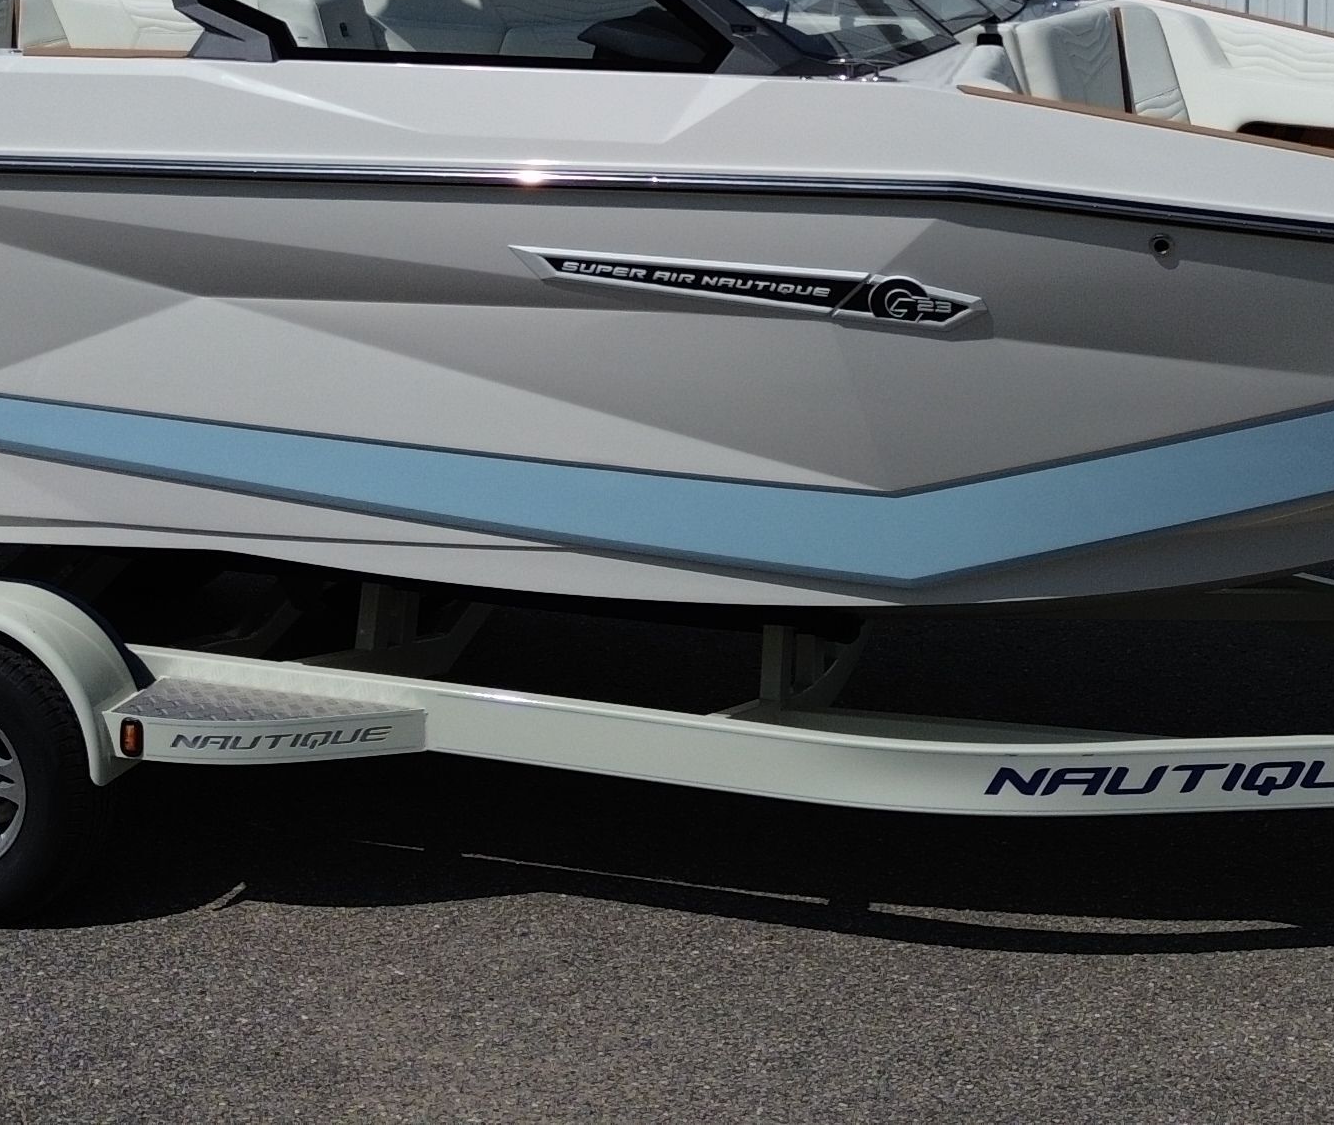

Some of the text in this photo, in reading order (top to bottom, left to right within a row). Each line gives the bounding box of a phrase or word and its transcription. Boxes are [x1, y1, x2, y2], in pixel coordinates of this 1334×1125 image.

[561, 260, 648, 279] SUPER
[651, 269, 697, 285] AIR
[700, 275, 832, 298] NAUTIQUE
[169, 725, 393, 751] NAUTIQUE
